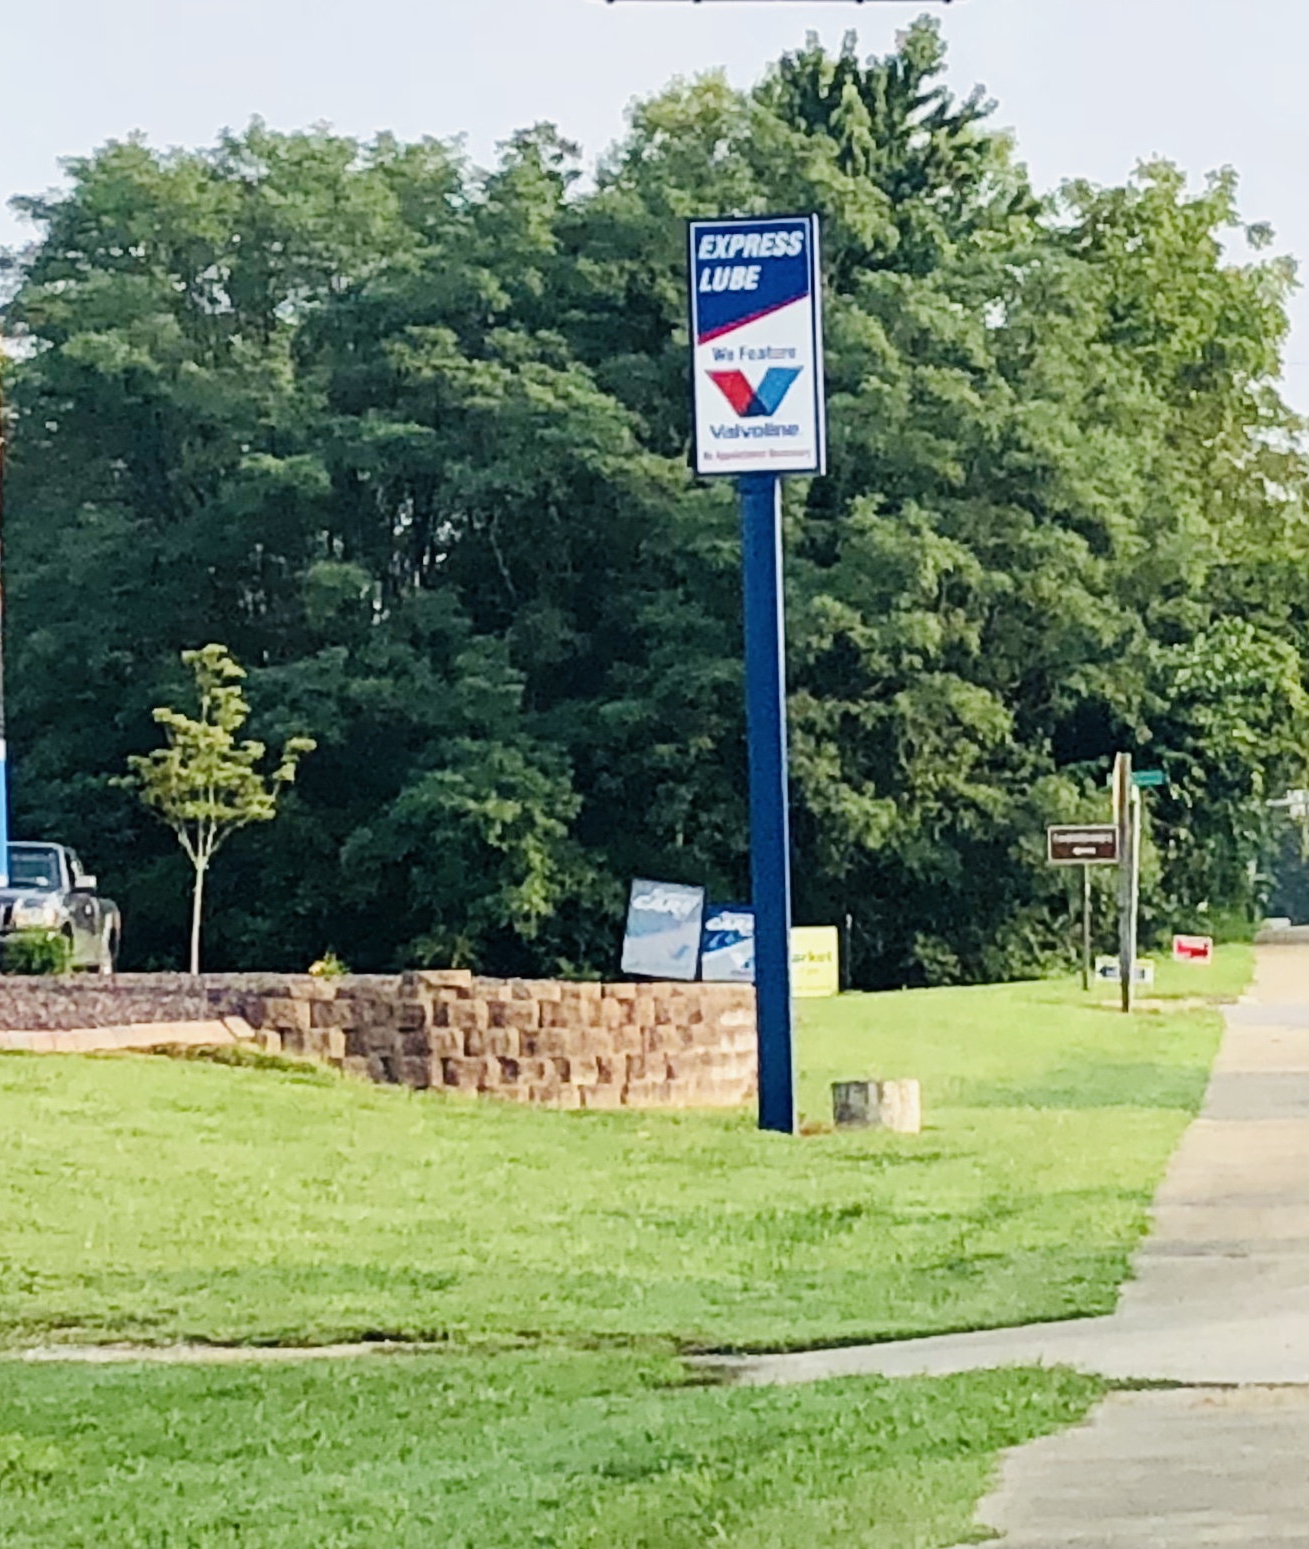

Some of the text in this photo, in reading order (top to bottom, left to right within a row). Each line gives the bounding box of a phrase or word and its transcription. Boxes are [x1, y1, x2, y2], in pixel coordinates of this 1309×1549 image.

[698, 230, 804, 260] EXPRESS
[699, 265, 762, 293] LUBE
[712, 347, 734, 361] We
[709, 423, 800, 439] Valvoline
